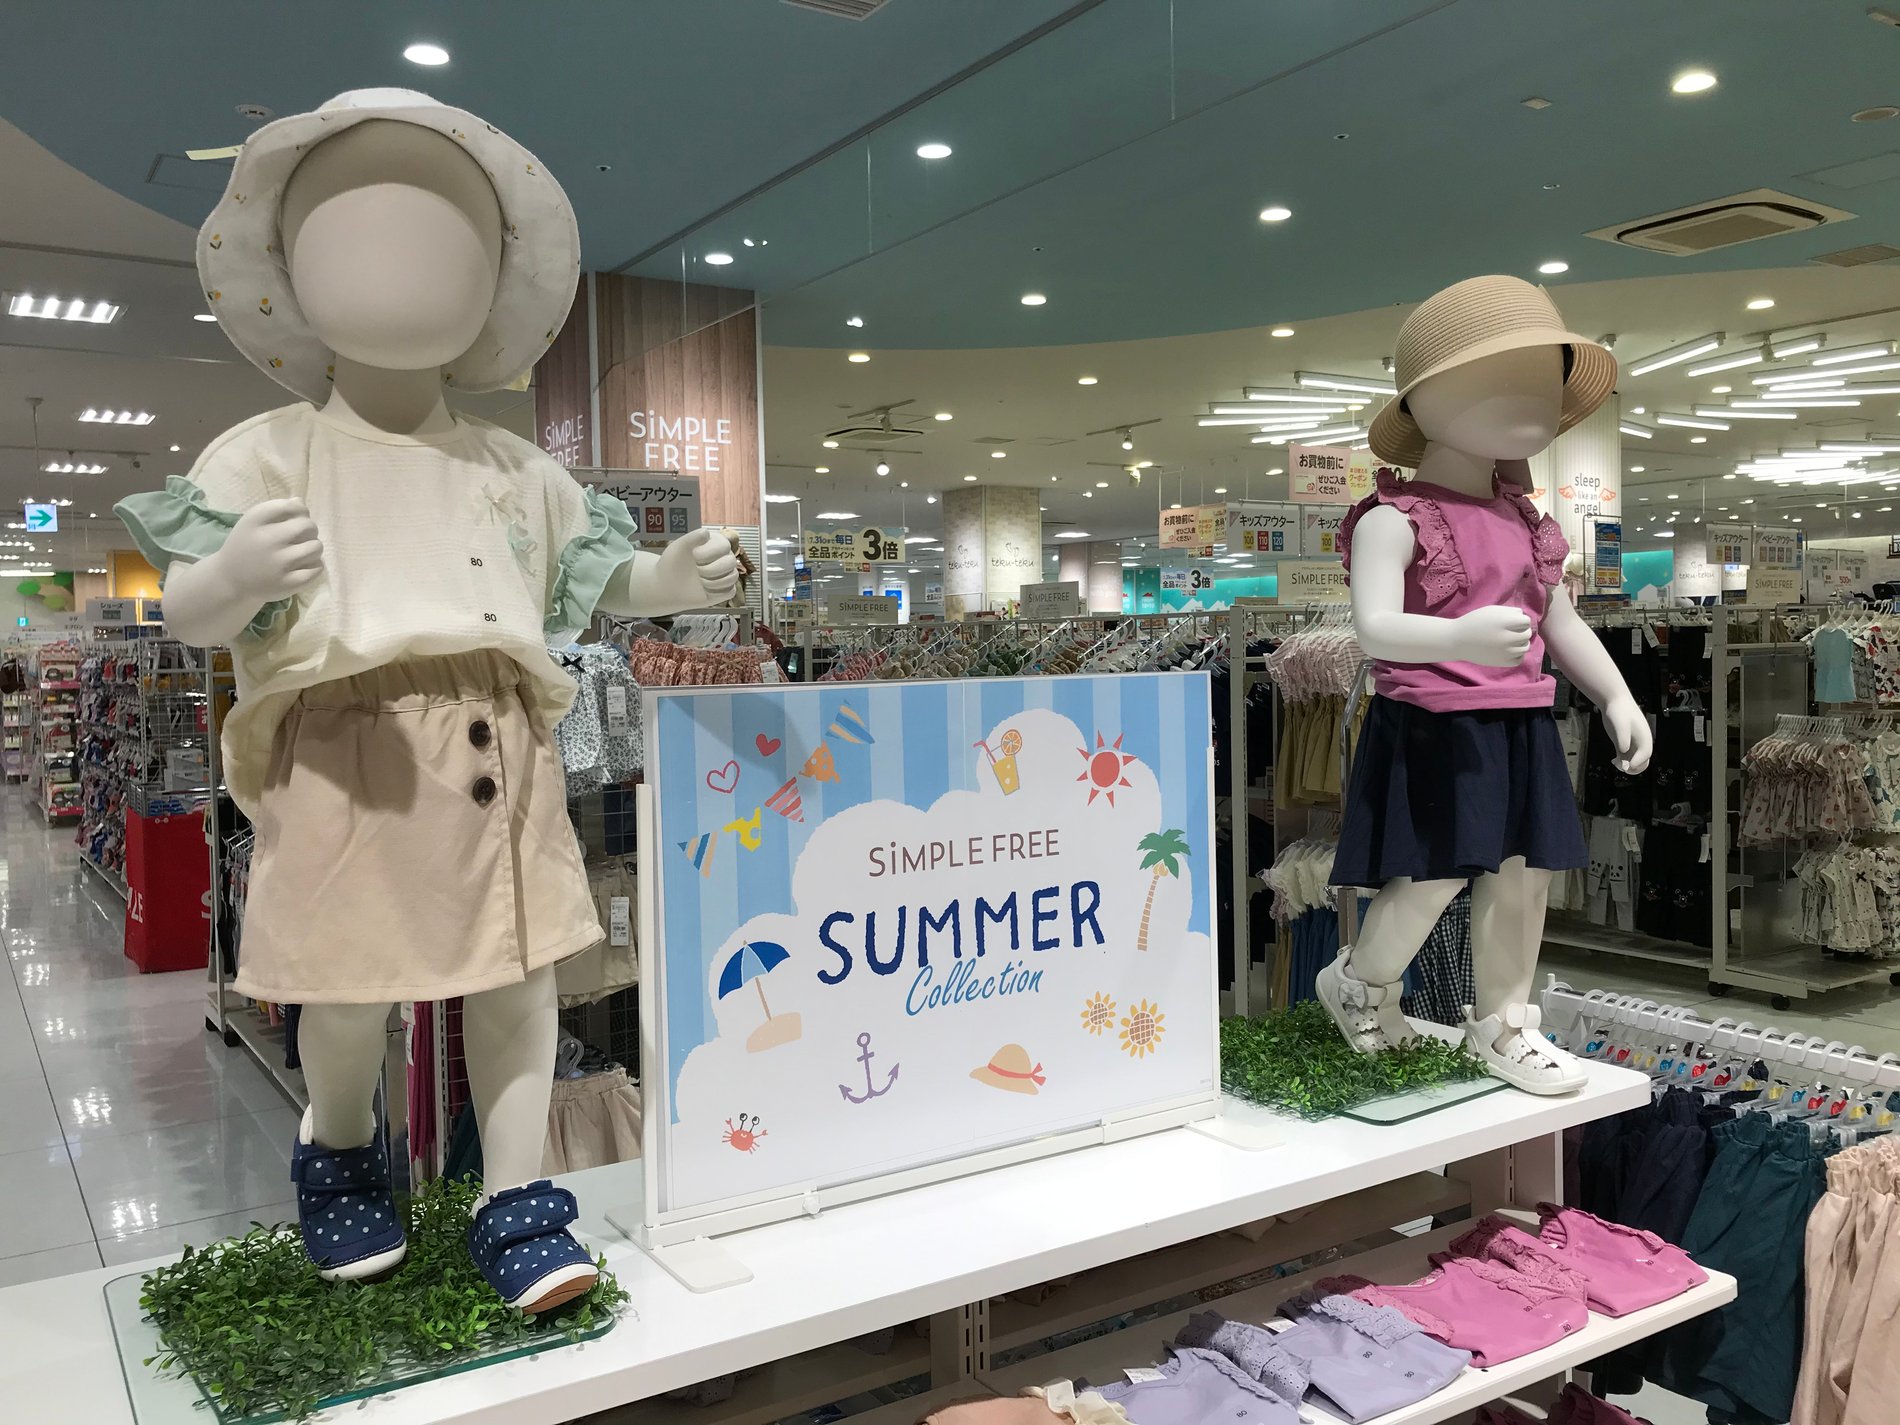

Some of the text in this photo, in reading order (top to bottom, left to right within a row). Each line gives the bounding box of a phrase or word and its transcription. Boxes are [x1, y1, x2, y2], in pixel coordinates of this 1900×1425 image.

[645, 443, 719, 472] FREE
[1299, 454, 1344, 470] お買物前に
[1574, 473, 1601, 491] sleep
[1318, 486, 1341, 495] ください
[1574, 502, 1602, 517] angel
[647, 514, 662, 526] 90
[671, 514, 686, 526] 95
[1239, 514, 1295, 528] キッズアウター
[1272, 535, 1283, 546] 120
[470, 557, 483, 567] 80
[1778, 579, 1793, 589] FREE
[1053, 591, 1070, 602] FREE
[869, 603, 889, 612] FREE
[483, 612, 497, 622] 80
[992, 828, 1060, 863] FREE
[817, 880, 1106, 985] SUMMER
[905, 957, 1044, 1017] Collection
[1236, 1409, 1248, 1418] 80
